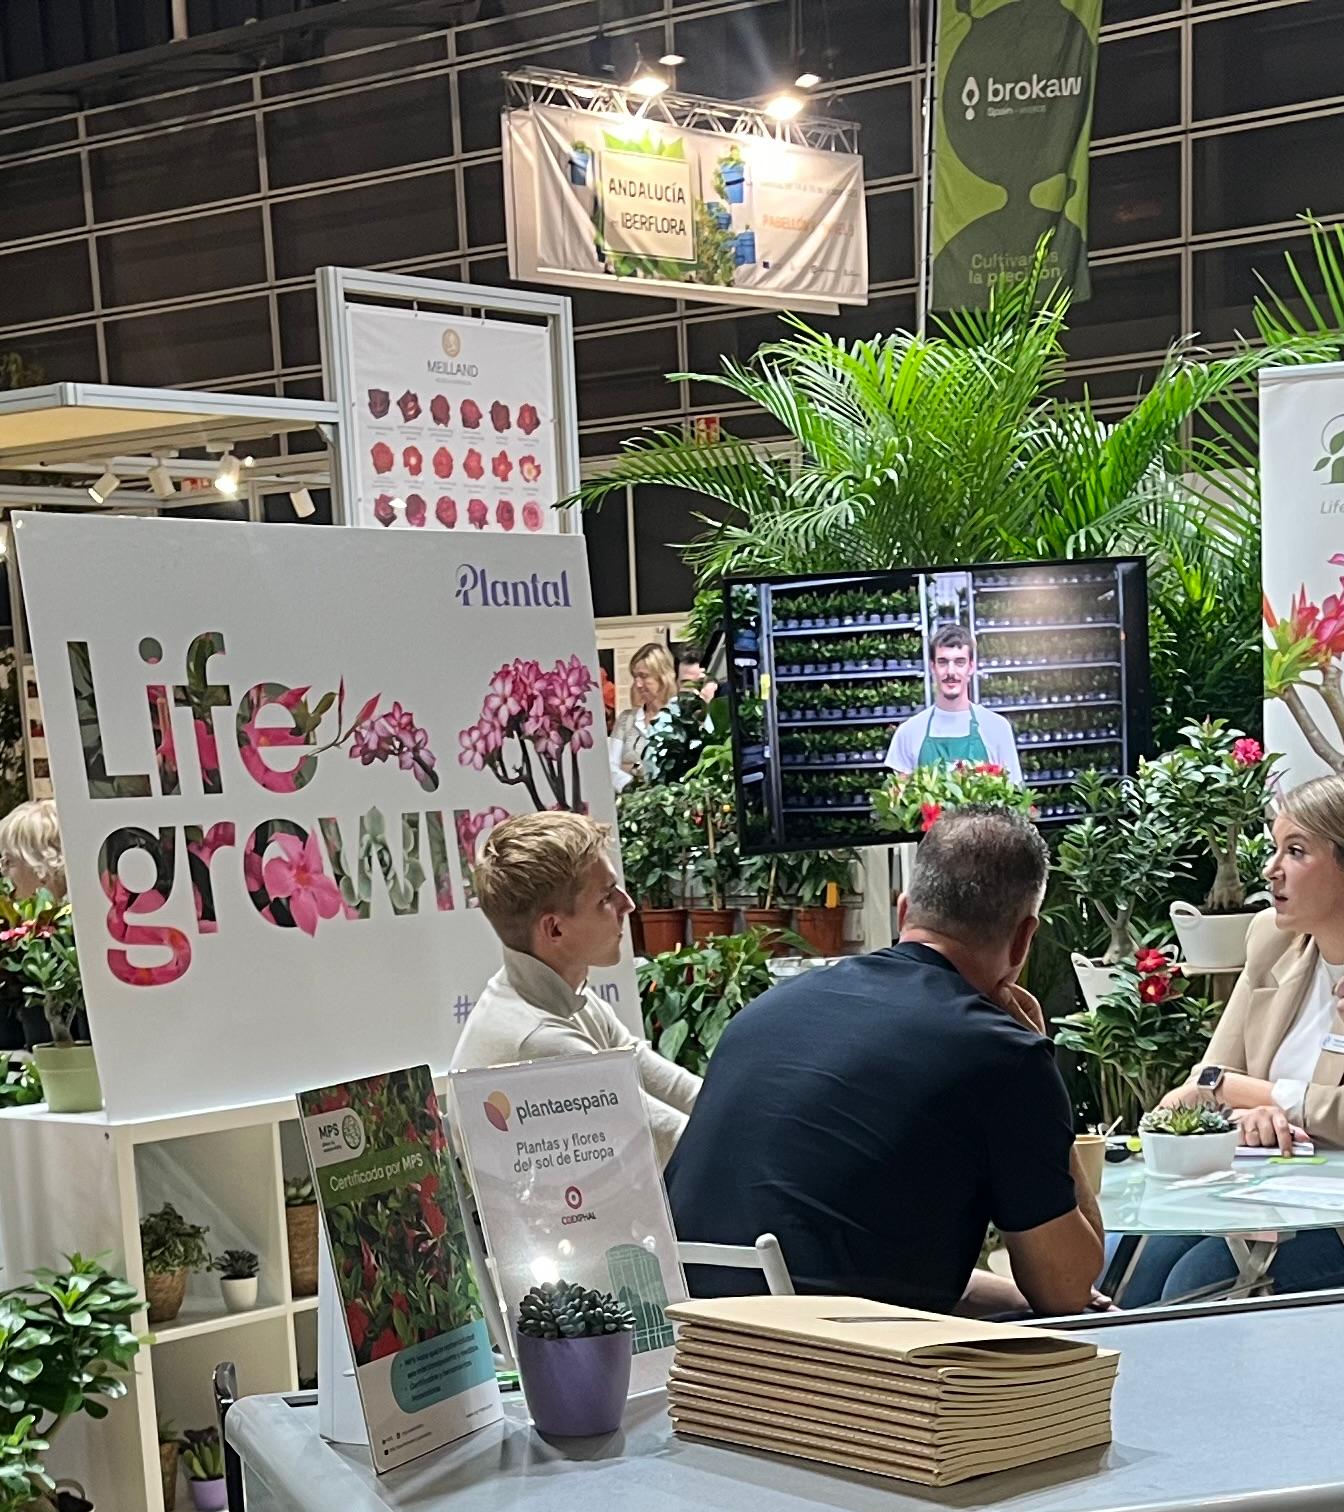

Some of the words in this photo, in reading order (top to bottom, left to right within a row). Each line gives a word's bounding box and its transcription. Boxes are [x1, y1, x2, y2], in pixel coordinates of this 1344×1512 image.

[987, 73, 1082, 102] brokaw
[609, 177, 686, 204] ANDALUCÍA
[621, 212, 687, 236] IBERFLORA
[427, 359, 479, 377] MEILLAND
[455, 563, 572, 608] Plantal
[66, 631, 318, 800] Life
[516, 1089, 619, 1125] plantaespaña
[318, 1123, 340, 1140] MPS
[516, 1138, 560, 1156] Plantas
[563, 1137, 569, 1151] y
[572, 1131, 606, 1147] flores
[385, 1161, 401, 1180] por
[401, 1152, 423, 1171] MPS
[514, 1157, 532, 1173] del
[535, 1153, 554, 1169] sol
[557, 1152, 571, 1166] de
[573, 1147, 614, 1162] Europa
